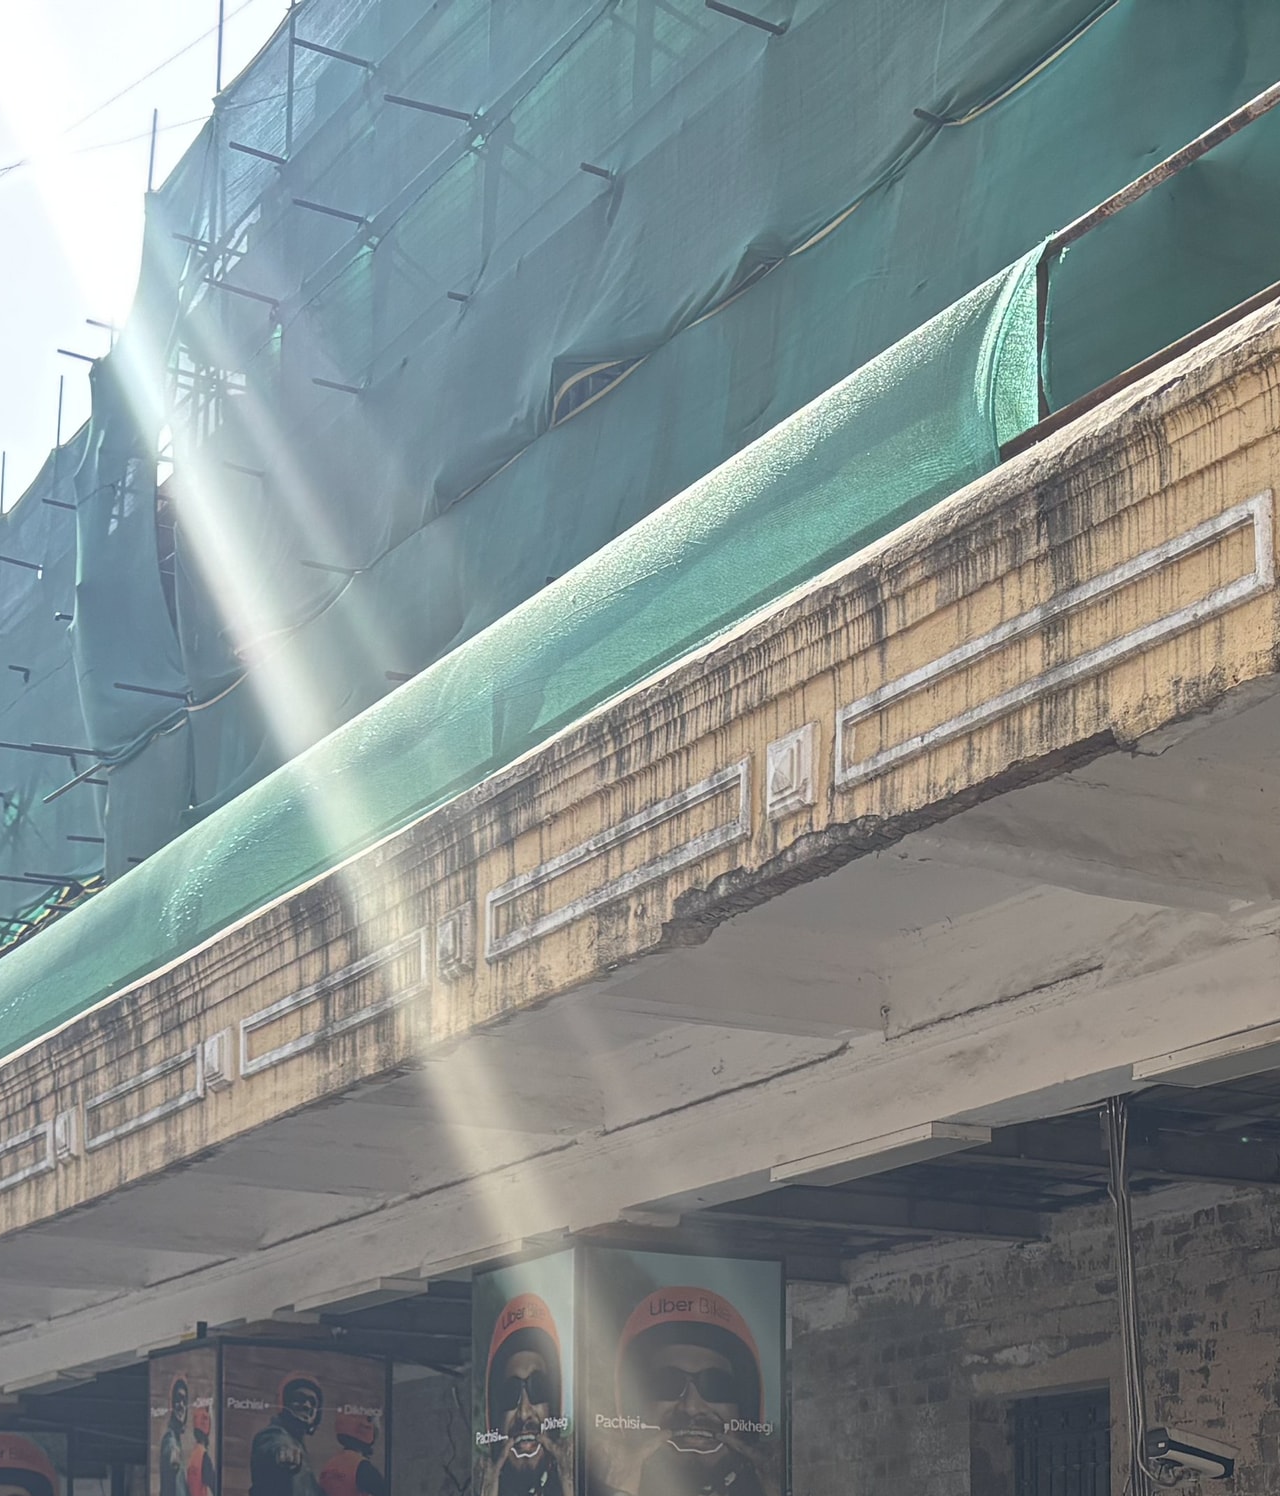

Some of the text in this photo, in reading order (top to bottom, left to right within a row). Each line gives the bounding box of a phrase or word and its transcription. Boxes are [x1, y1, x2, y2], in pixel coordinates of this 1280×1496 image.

[650, 1298, 694, 1316] Uber
[502, 1307, 526, 1330] Uber
[227, 1397, 264, 1410] Pachisi
[543, 1416, 568, 1431] Dikhegi
[595, 1413, 640, 1430] Pachisi
[730, 1419, 773, 1436] Dikhegi
[475, 1428, 499, 1444] Pachisi
